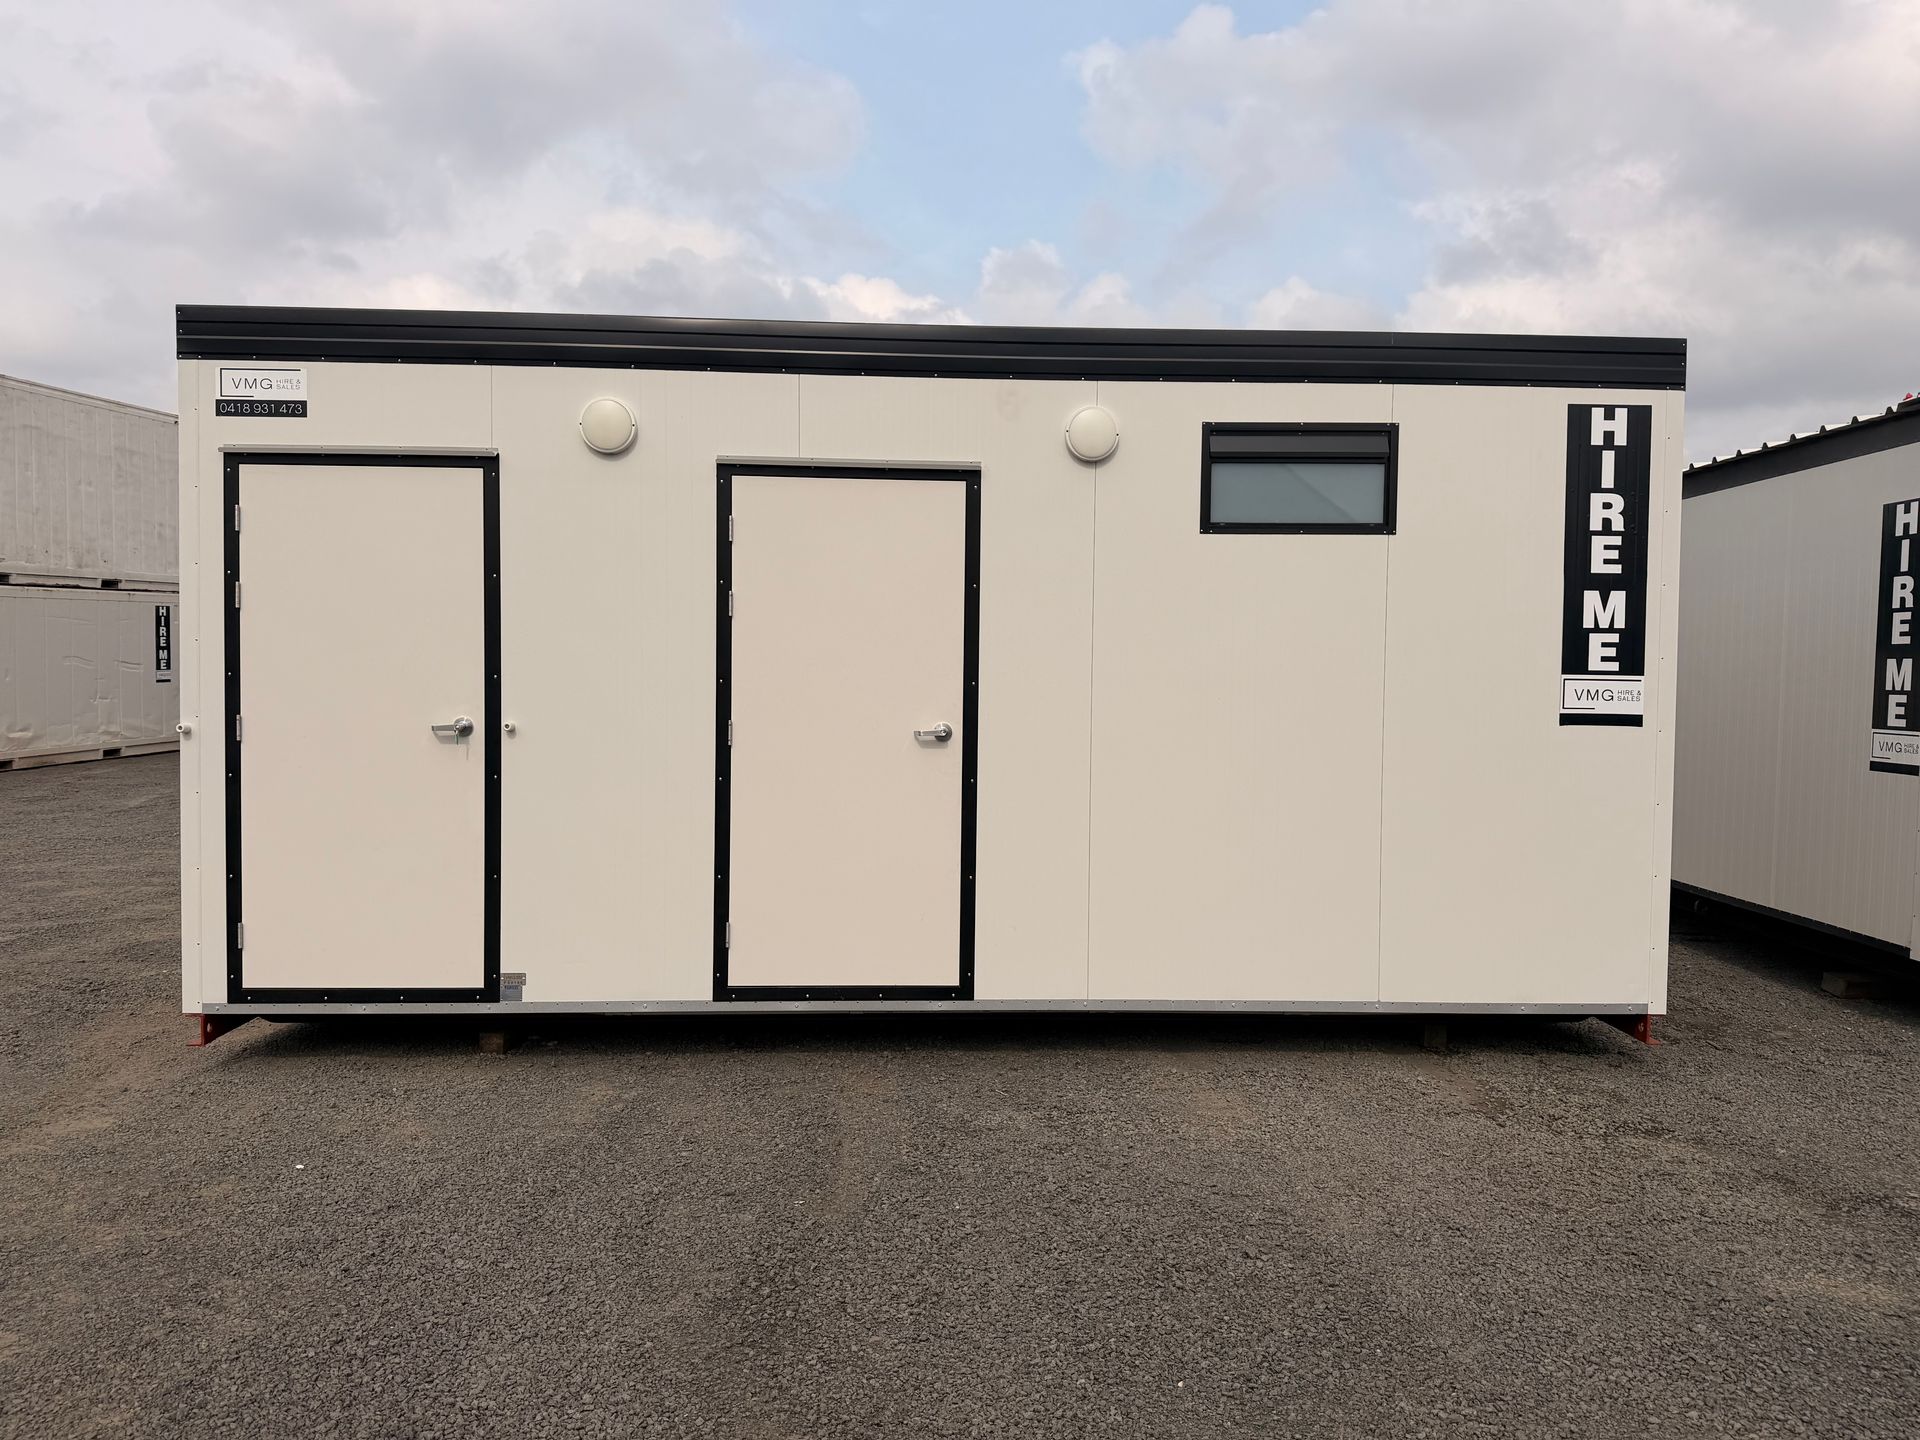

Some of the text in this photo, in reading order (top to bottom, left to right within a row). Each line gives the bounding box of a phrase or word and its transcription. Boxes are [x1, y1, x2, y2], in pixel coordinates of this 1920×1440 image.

[231, 377, 273, 390] VMG
[220, 402, 302, 414] 0418 931 473
[1582, 407, 1628, 672] HIRE ME
[1885, 501, 1919, 728] HIRE ME
[159, 606, 167, 646] HIRE
[159, 650, 168, 669] ME
[1574, 688, 1614, 702] VMG
[1878, 741, 1902, 752] VMG
